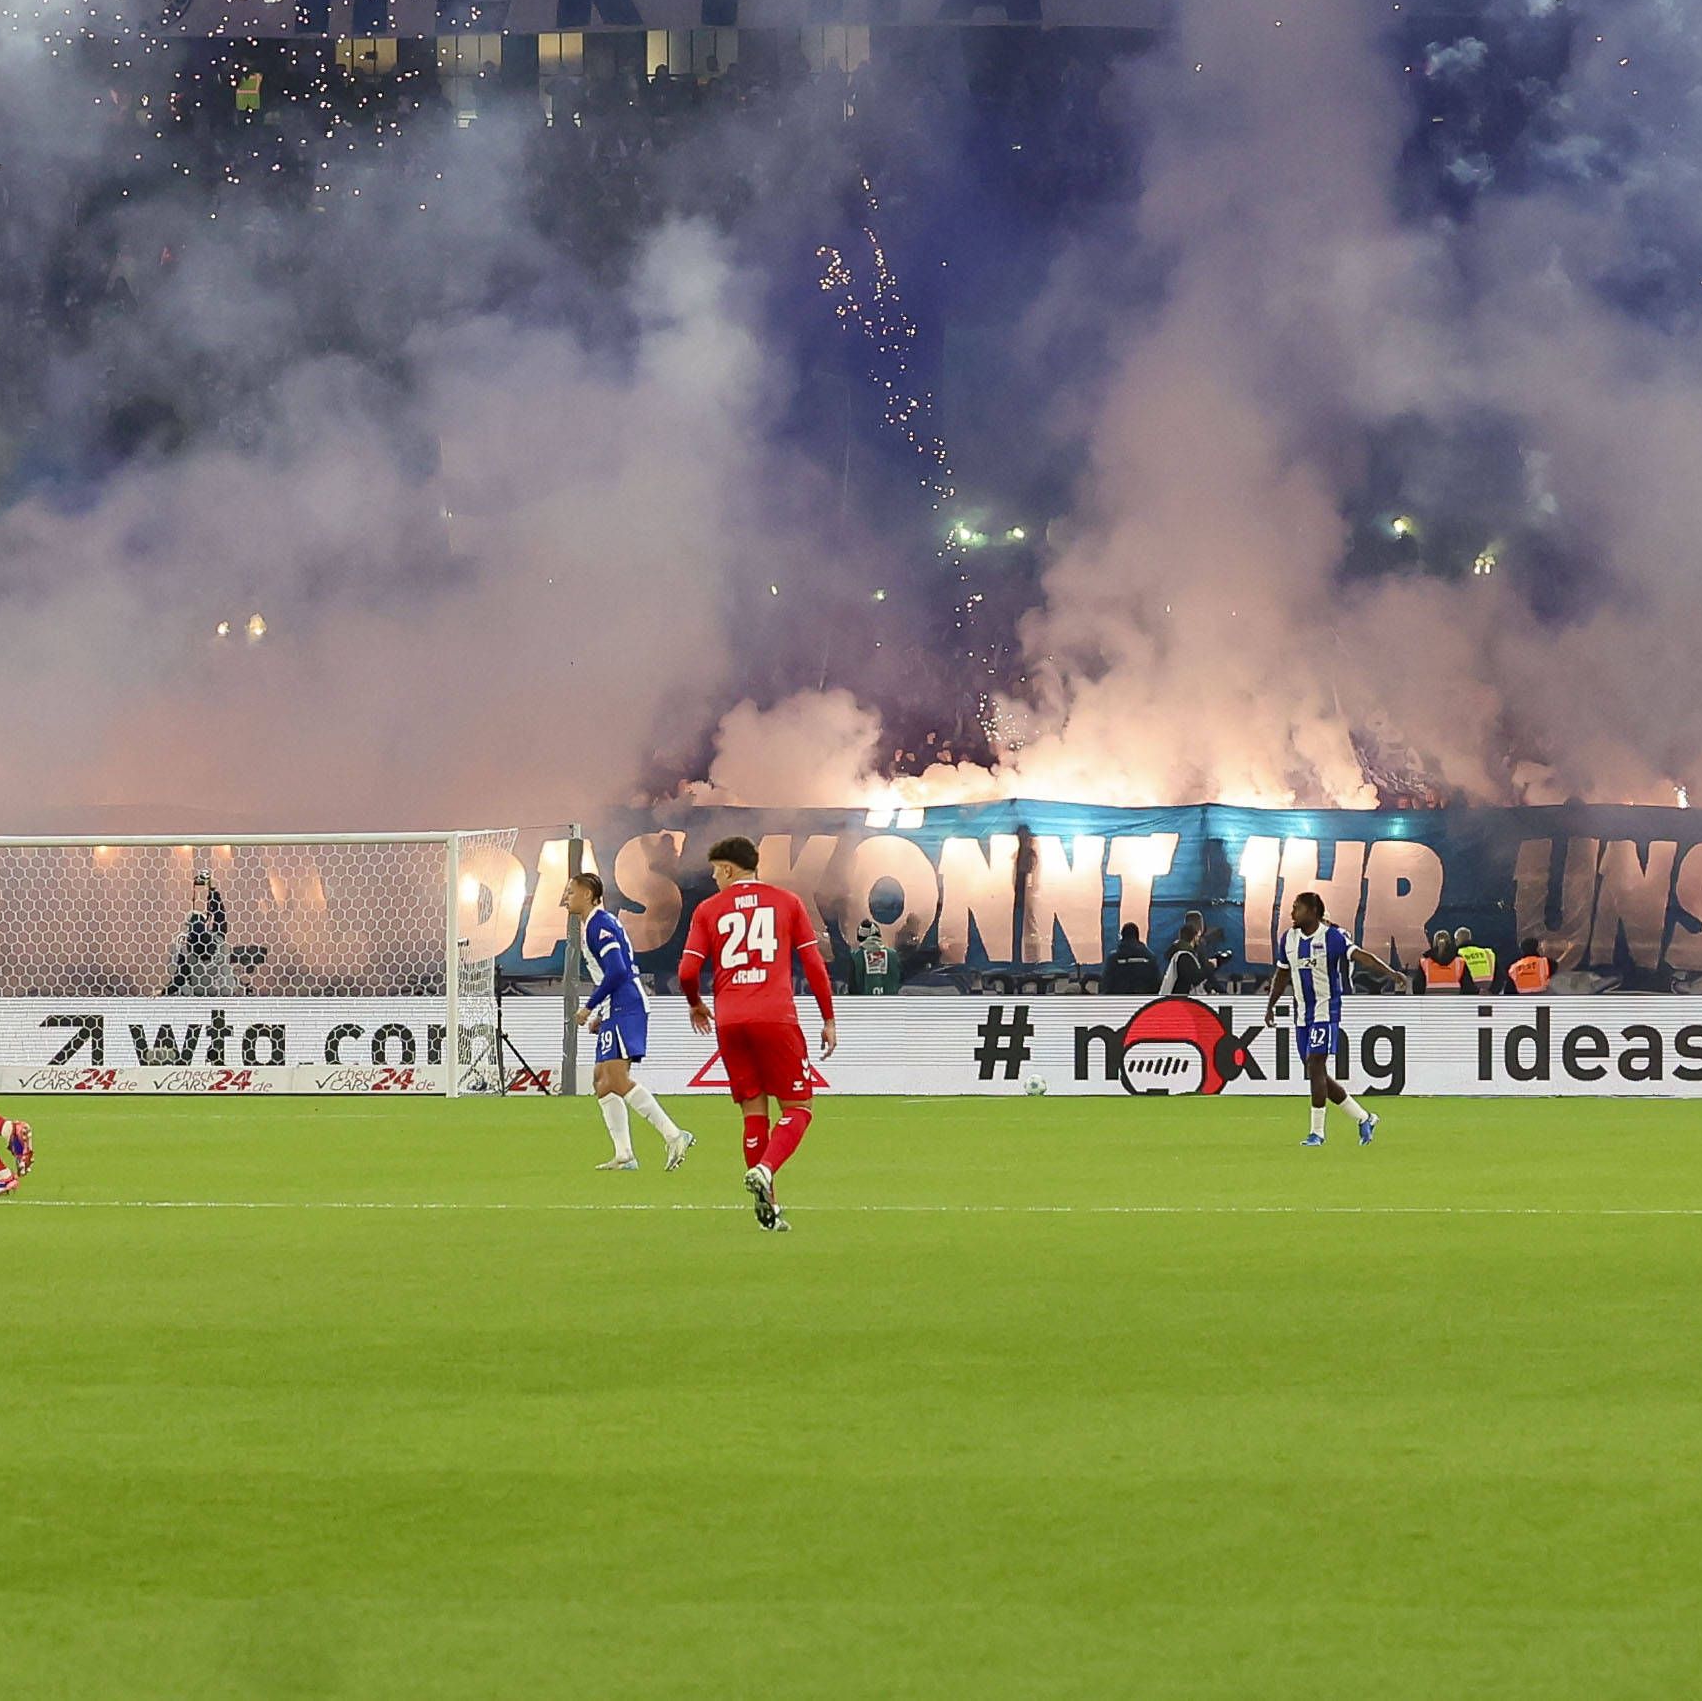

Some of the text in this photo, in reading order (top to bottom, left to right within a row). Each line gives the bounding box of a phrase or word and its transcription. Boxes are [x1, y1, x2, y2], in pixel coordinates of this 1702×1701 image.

[451, 826, 688, 965] DAS
[757, 808, 1180, 966] KÖNNT
[1237, 834, 1445, 968] IHR
[717, 906, 778, 969] 24
[128, 1009, 498, 1066] wtgcom
[974, 1005, 1035, 1080] #
[1075, 1005, 1406, 1095] mkig
[1309, 1028, 1326, 1045] 42
[74, 1068, 117, 1091] 24
[208, 1069, 254, 1091] 24
[371, 1067, 415, 1091] 24
